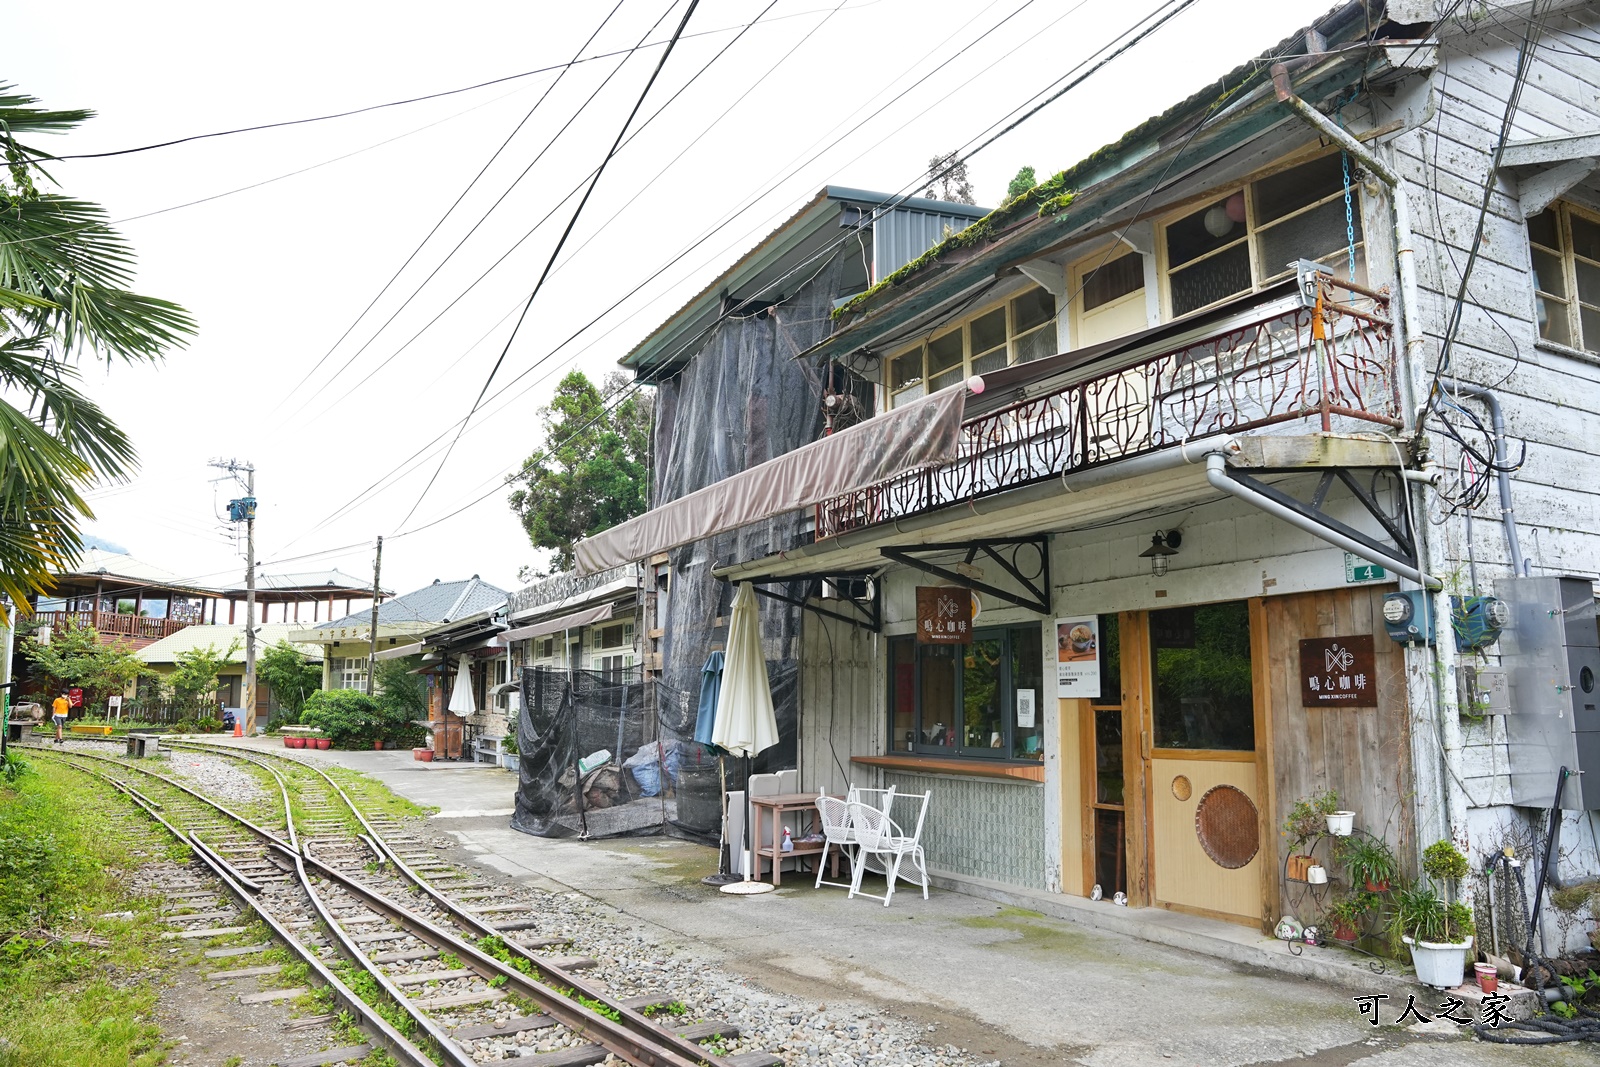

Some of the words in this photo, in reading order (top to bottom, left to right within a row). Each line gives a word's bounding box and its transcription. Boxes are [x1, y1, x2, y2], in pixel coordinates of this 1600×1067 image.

[1364, 566, 1374, 578] 4
[924, 619, 966, 633] 鳴心咖啡
[1309, 674, 1366, 691] 鳴心咖啡
